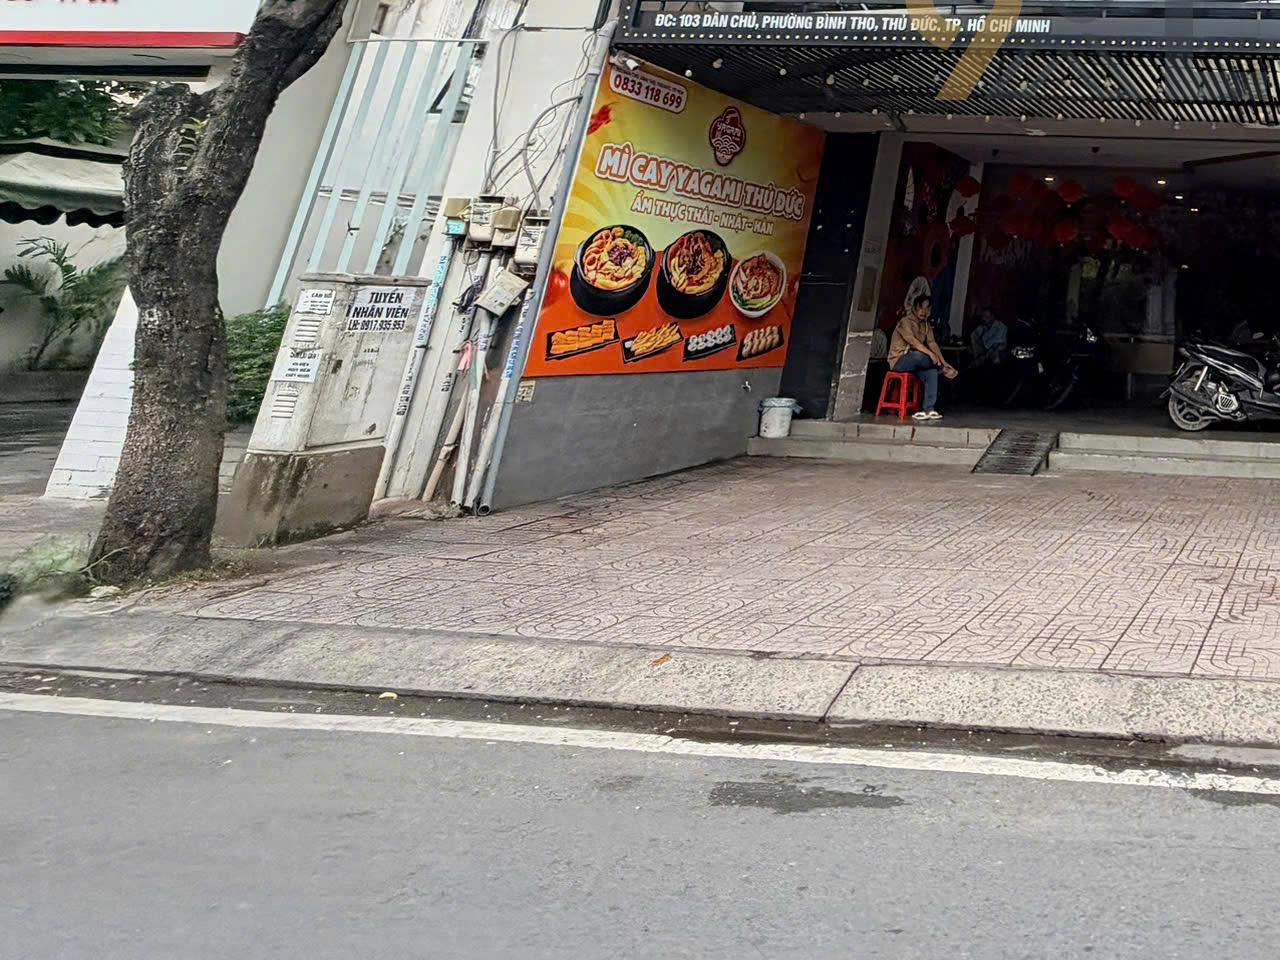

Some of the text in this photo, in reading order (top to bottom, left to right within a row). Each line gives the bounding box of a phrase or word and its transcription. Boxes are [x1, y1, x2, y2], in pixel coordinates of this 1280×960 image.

[679, 14, 700, 28] 103
[702, 12, 728, 28] DÂN
[1015, 19, 1051, 33] MINH
[614, 74, 642, 96] 0833
[645, 85, 662, 103] 118
[662, 92, 682, 108] 699
[634, 153, 675, 187] CAY
[676, 164, 743, 206] YAGAMI
